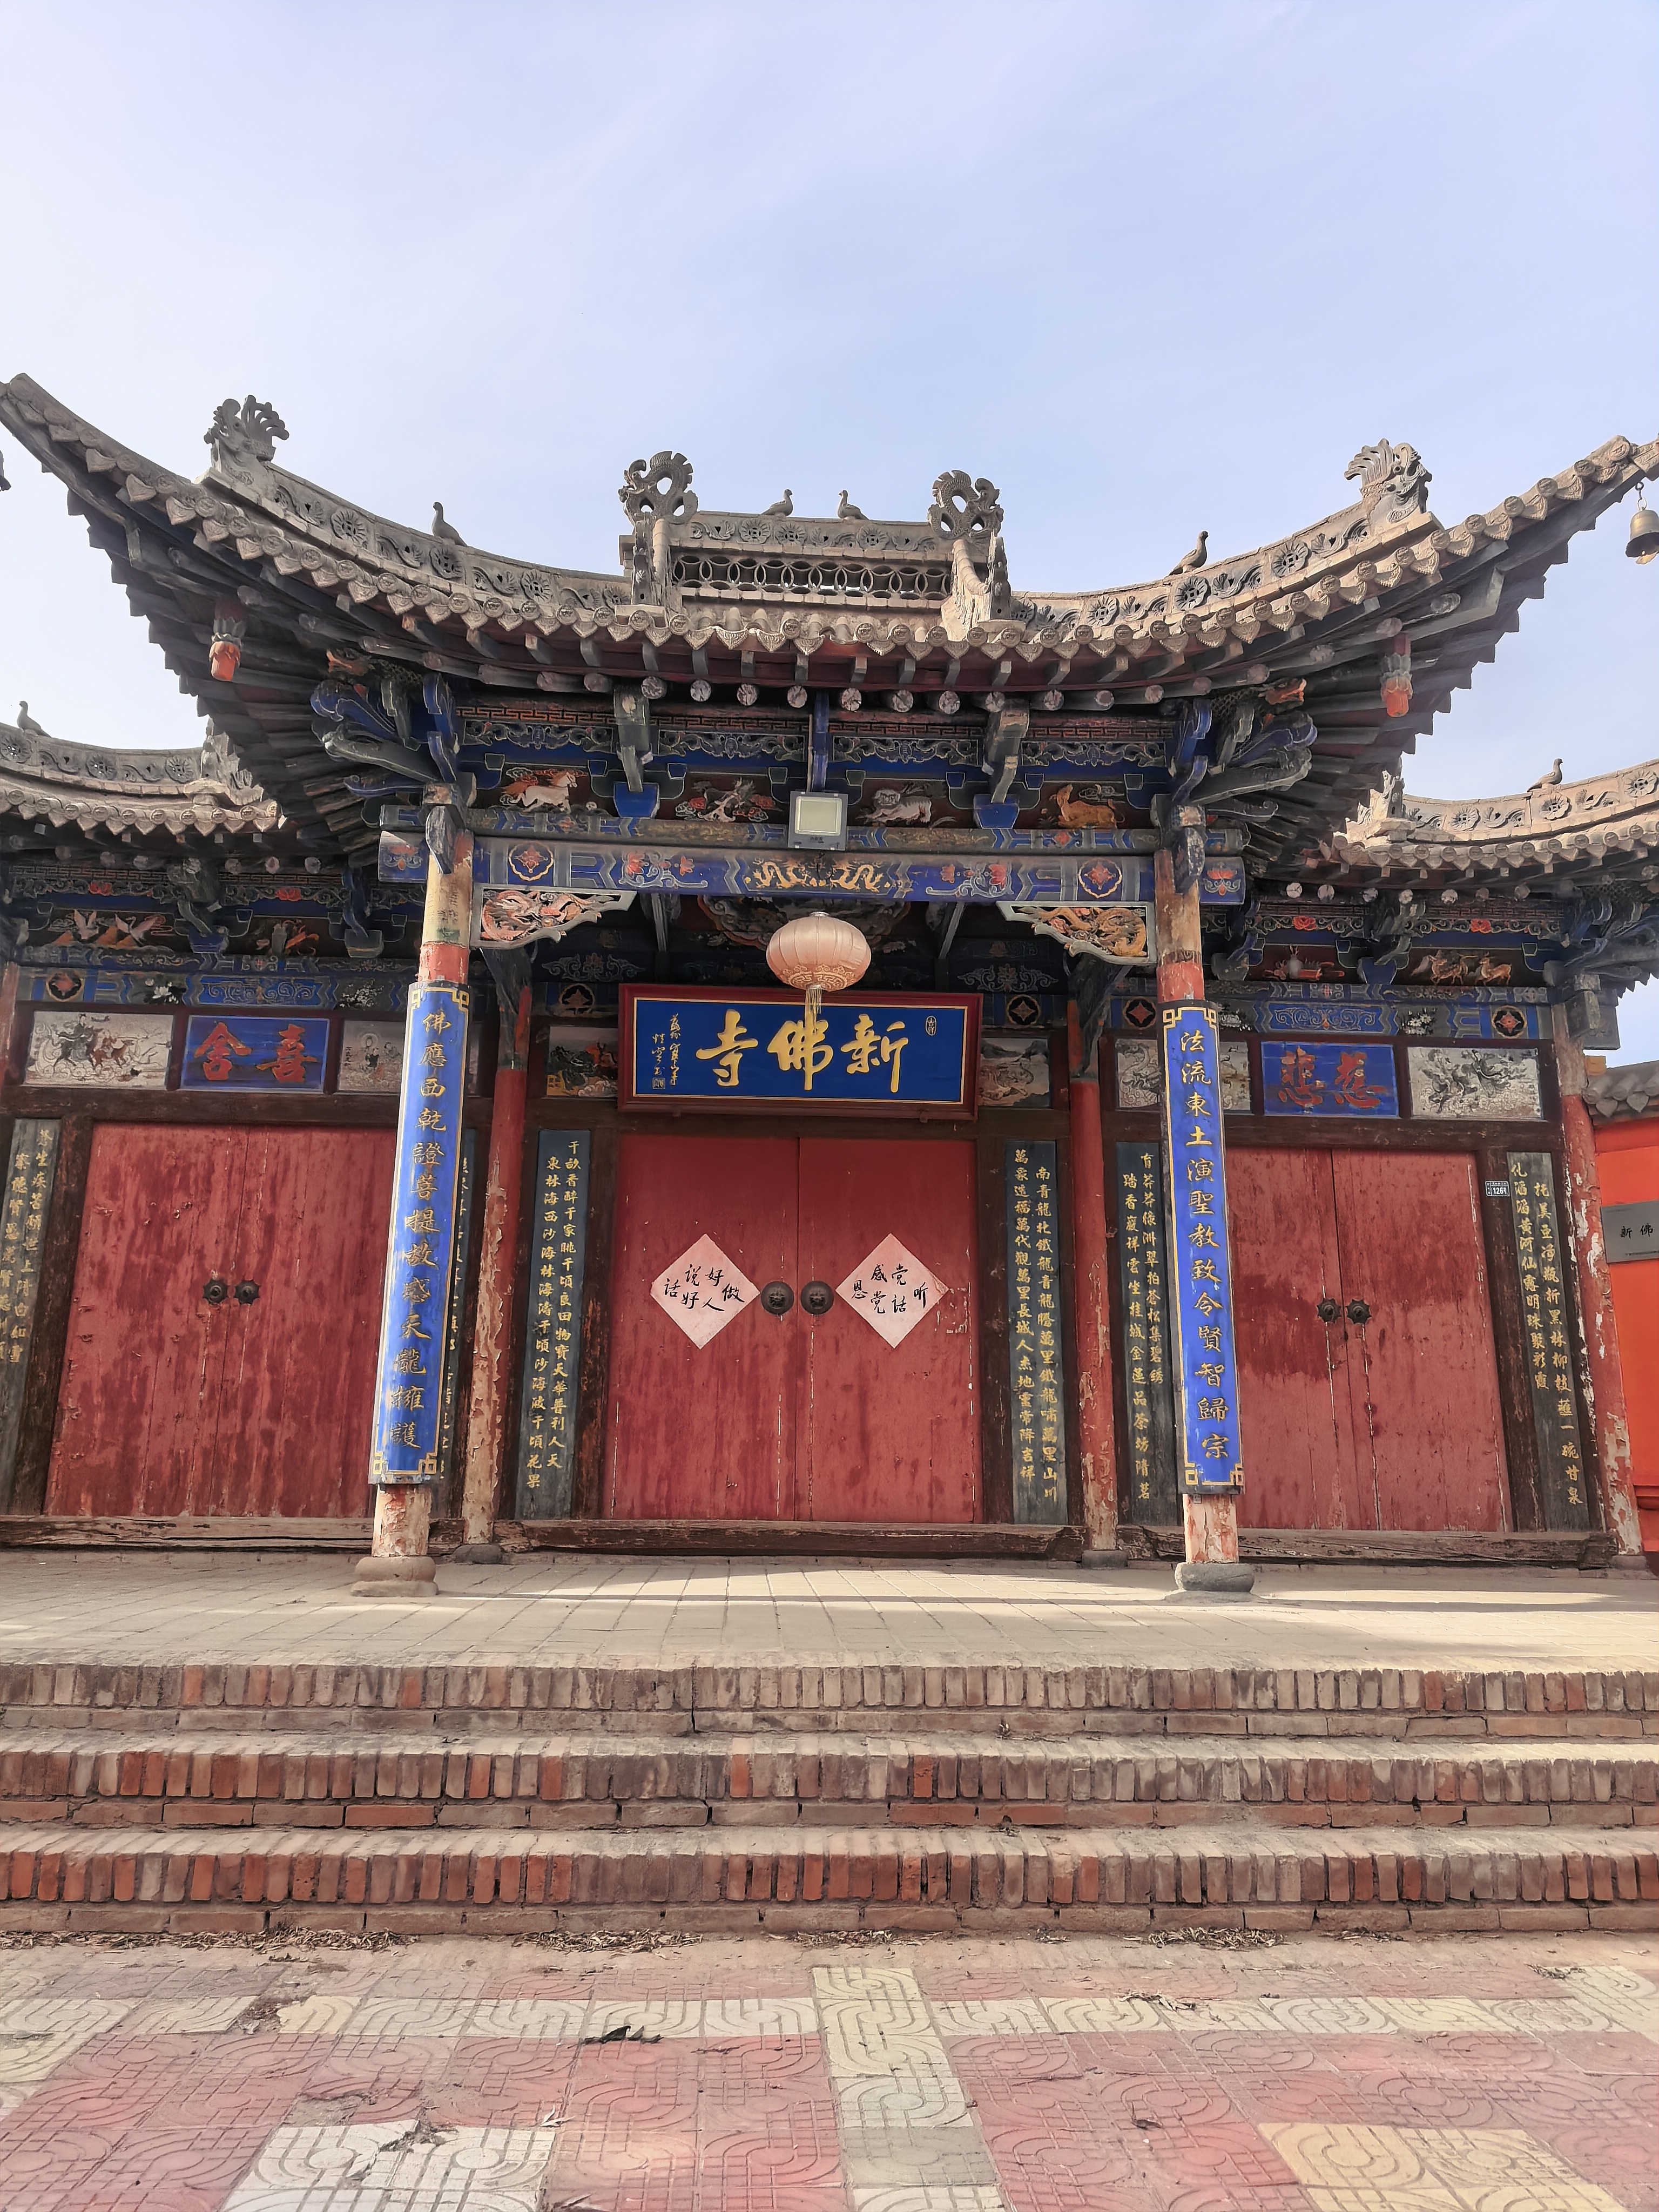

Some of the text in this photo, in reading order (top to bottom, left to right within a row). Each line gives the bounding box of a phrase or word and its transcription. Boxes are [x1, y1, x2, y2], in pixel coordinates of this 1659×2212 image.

[696, 1009, 908, 1092] 新佛寺
[1180, 1031, 1229, 1459] 法流東土演聖教致令賢智歸宗
